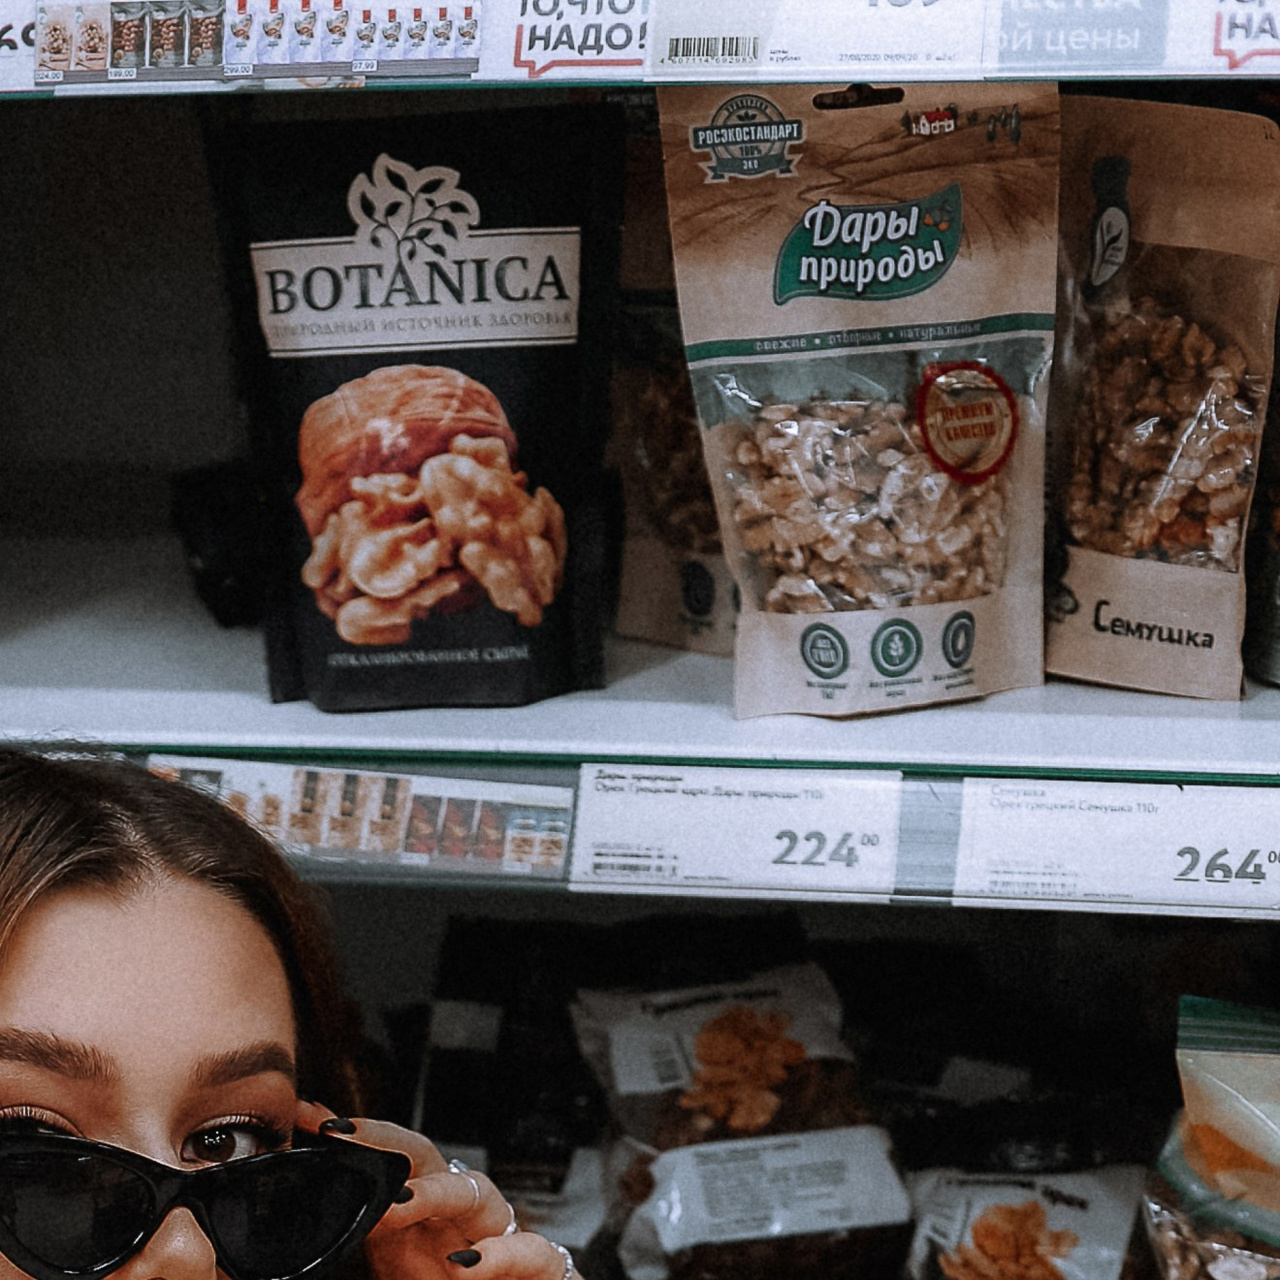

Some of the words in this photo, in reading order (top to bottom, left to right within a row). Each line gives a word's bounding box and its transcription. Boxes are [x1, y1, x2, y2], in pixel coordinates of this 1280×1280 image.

[528, 22, 648, 55] НАДО!
[1045, 28, 1140, 55] цены
[698, 123, 799, 145] РОСЭКОСТАНДАРТ
[804, 200, 919, 253] Дары
[266, 255, 571, 315] BOTANICA
[799, 240, 944, 291] природы
[1094, 599, 1215, 649] Семушка
[772, 828, 861, 867] 224
[1173, 846, 1267, 885] 264
